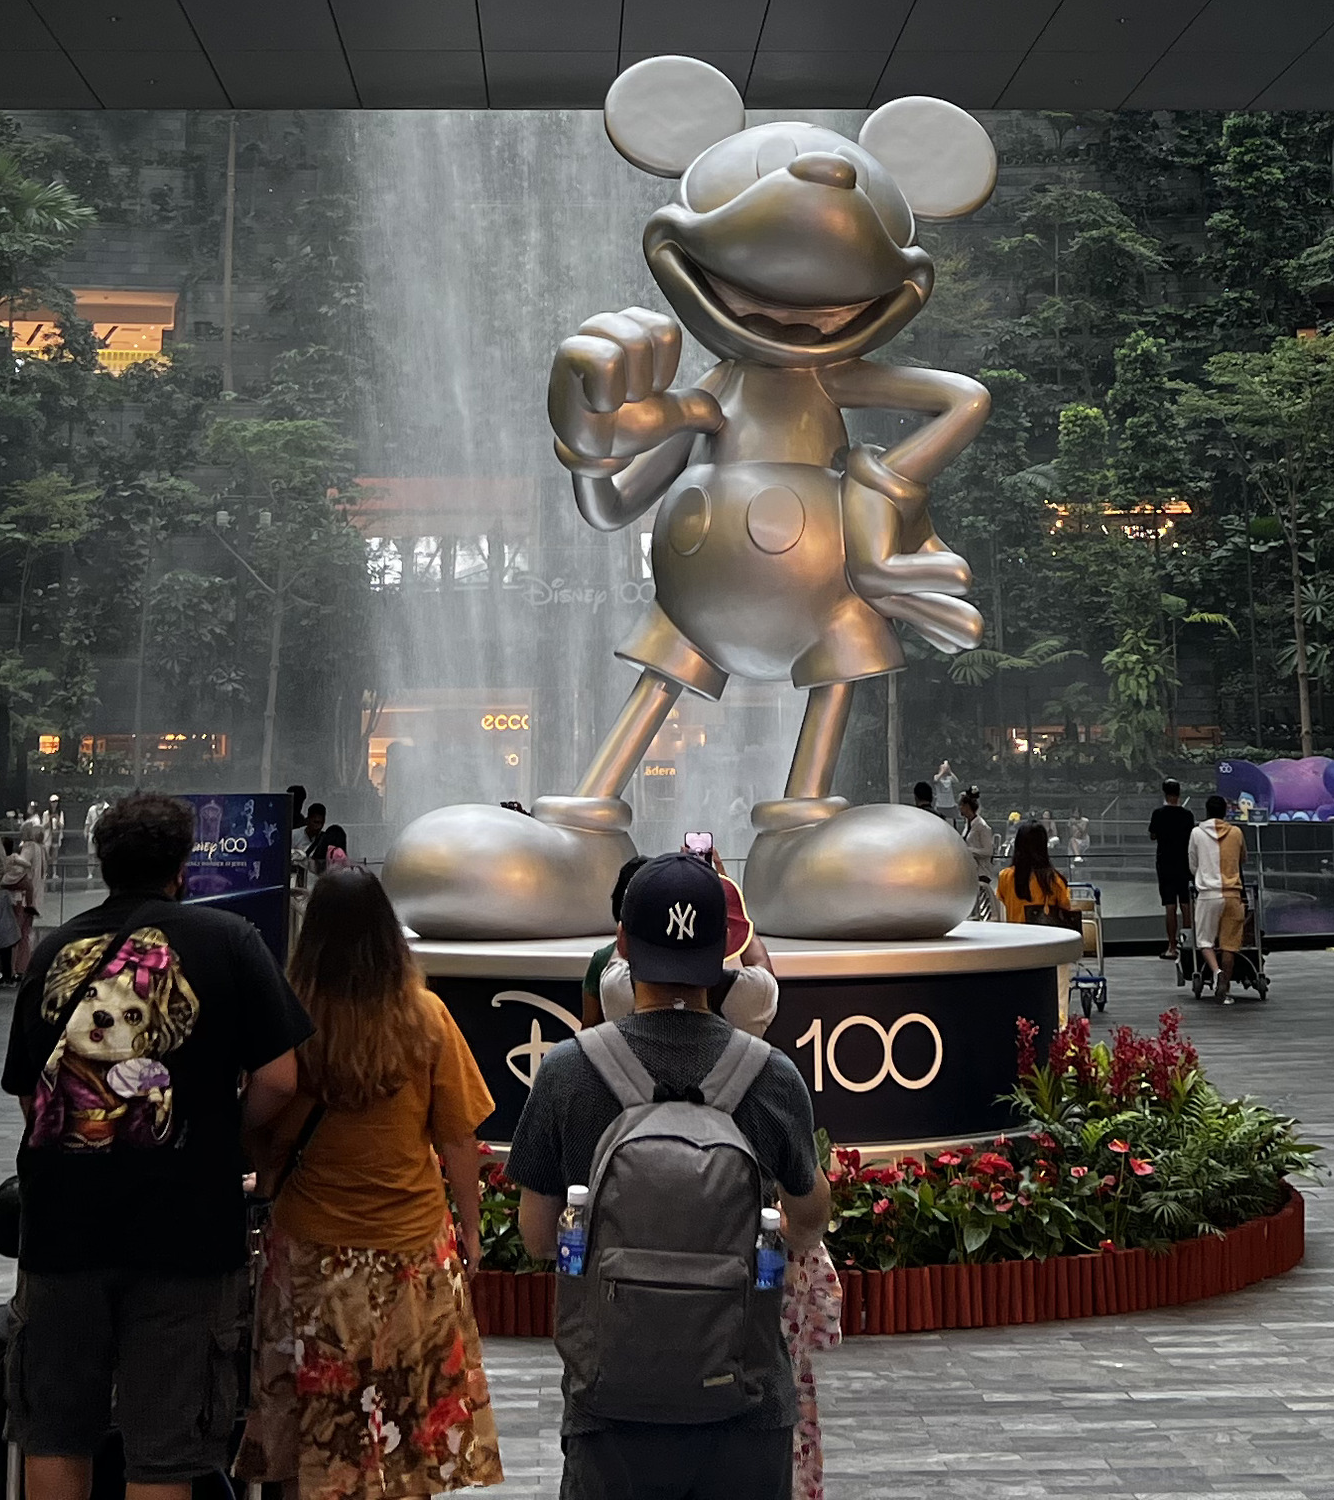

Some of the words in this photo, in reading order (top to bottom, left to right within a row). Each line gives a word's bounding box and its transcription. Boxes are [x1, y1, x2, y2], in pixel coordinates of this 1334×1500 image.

[517, 575, 607, 614] Disney
[610, 582, 656, 604] 100
[218, 837, 248, 853] 100
[665, 901, 697, 940] NY
[795, 1012, 944, 1093] 100
